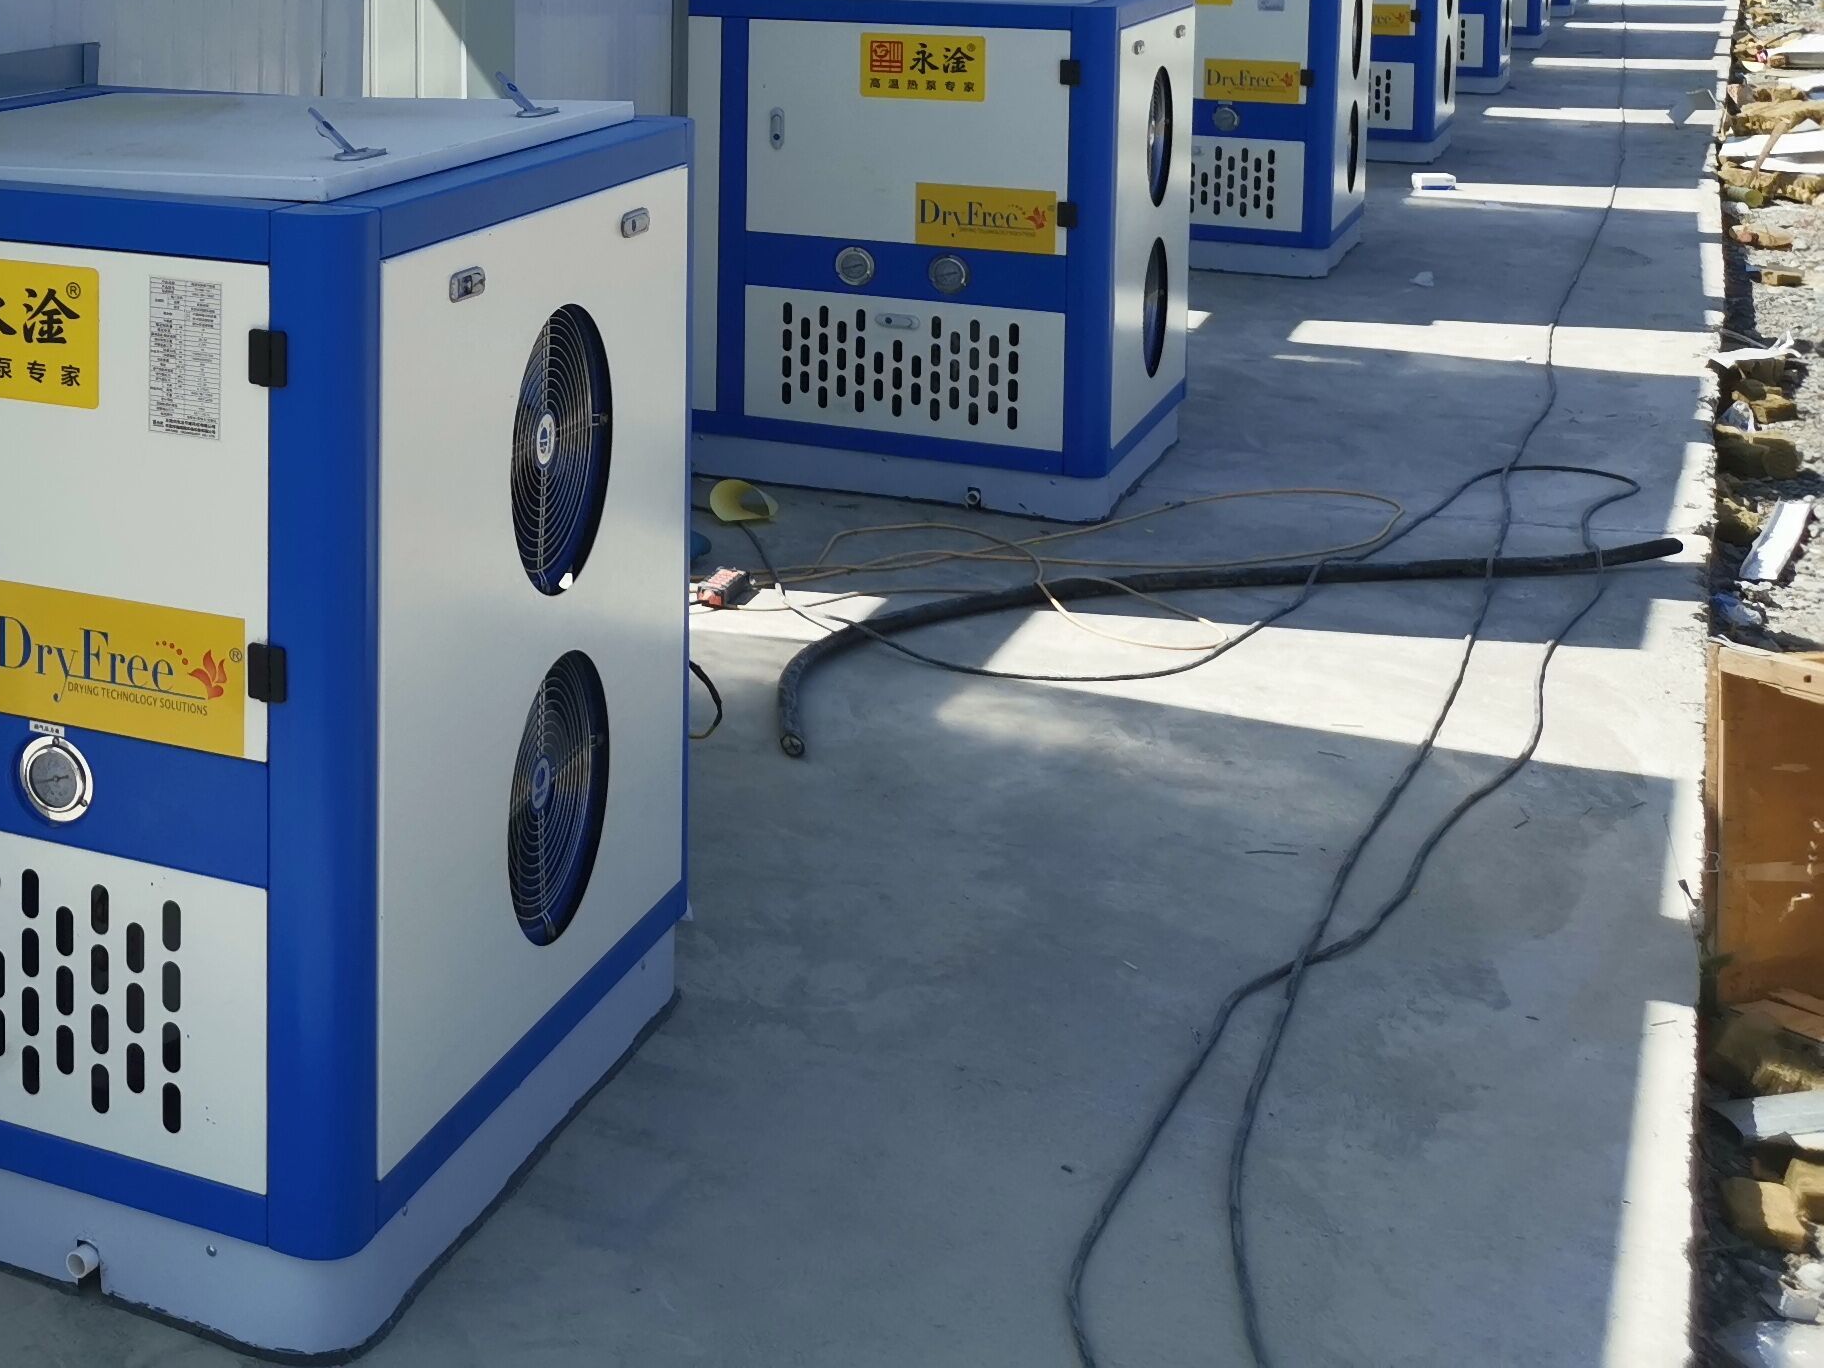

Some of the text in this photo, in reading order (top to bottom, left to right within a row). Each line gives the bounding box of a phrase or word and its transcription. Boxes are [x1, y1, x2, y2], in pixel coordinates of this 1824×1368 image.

[909, 42, 975, 75] 永淦
[67, 681, 208, 717] DRYING TECHNOLOGY SOLUTIONS
